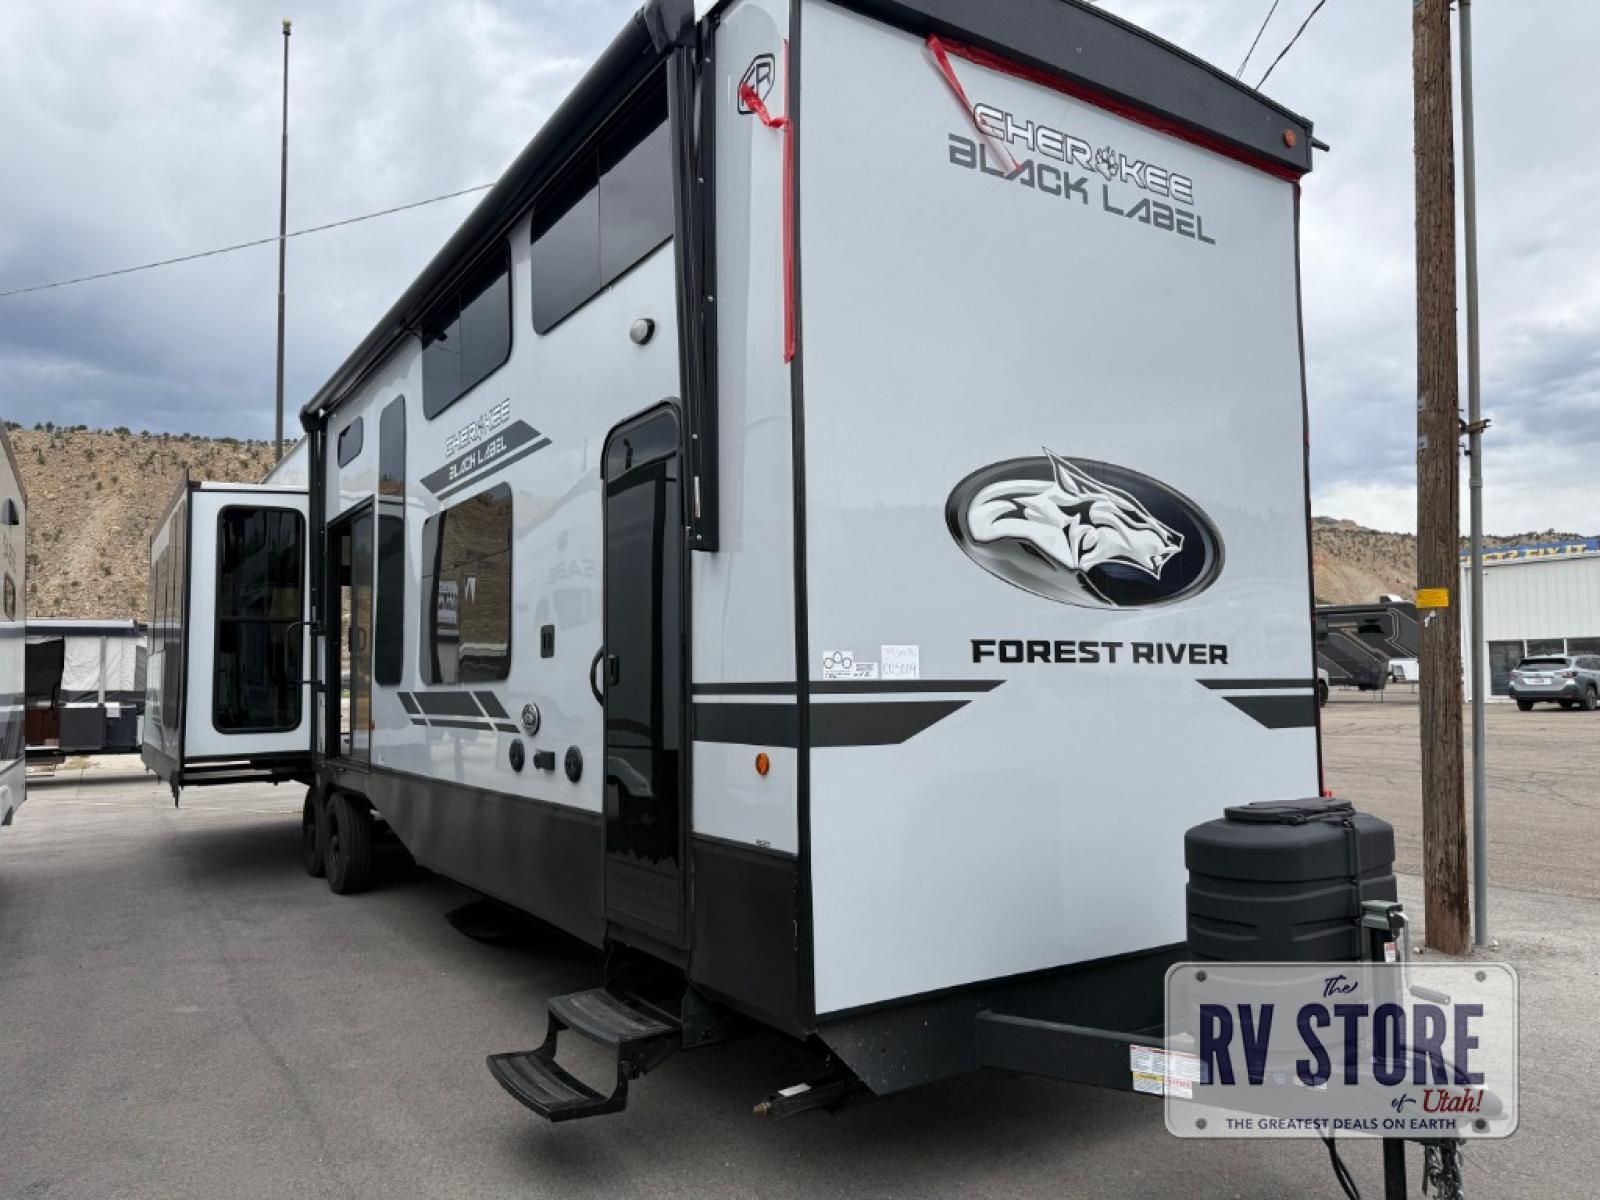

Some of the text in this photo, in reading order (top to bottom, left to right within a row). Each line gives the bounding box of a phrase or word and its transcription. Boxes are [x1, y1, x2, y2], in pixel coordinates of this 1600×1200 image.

[948, 132, 1216, 246] BLACK LABEL
[477, 435, 507, 465] LABEL
[970, 639, 1229, 665] FOREST RIVER
